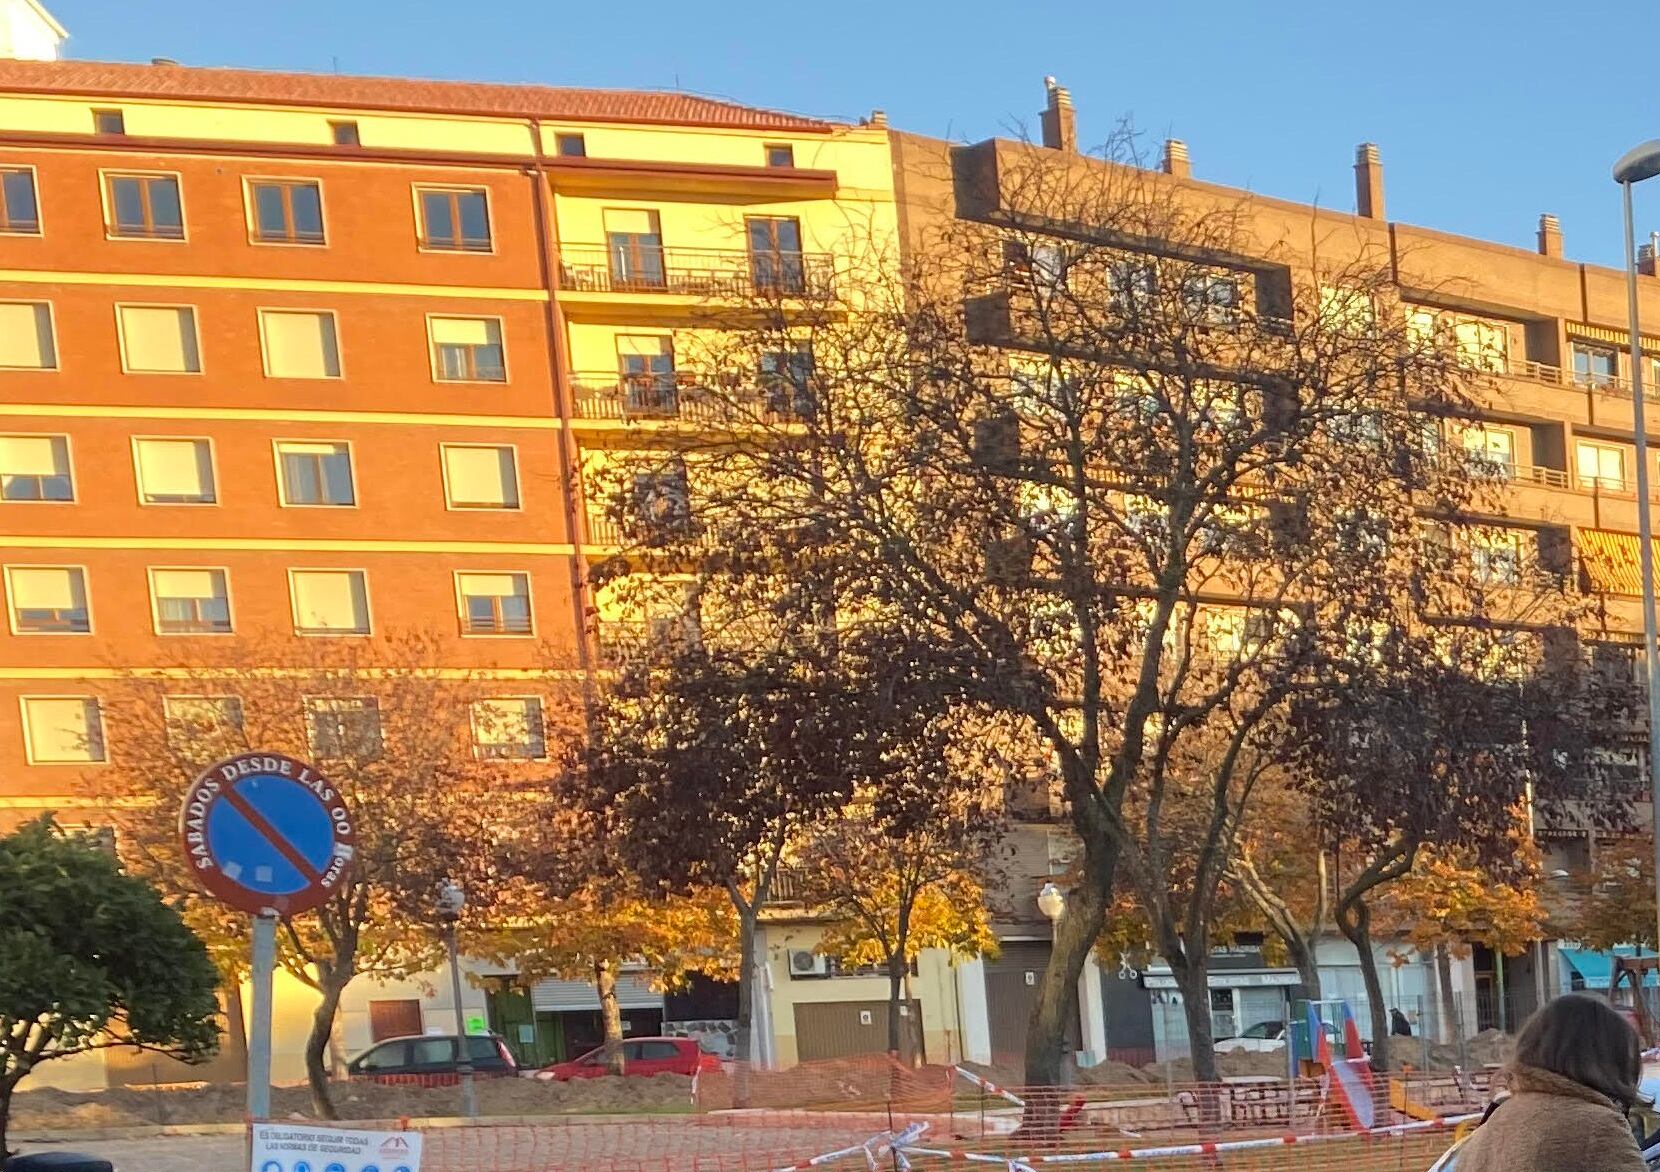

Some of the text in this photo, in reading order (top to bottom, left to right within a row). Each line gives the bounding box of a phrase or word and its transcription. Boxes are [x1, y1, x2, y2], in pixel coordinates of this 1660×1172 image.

[187, 777, 221, 870] SABADOS
[220, 757, 293, 782] DESDE
[299, 768, 335, 802] LAS
[270, 1131, 315, 1142] OBLIGATORIO
[316, 1134, 344, 1144] SEGUIR
[345, 1136, 369, 1146] TODAS
[265, 1142, 361, 1155] LAS NORMAS DE SEGURIDAD
